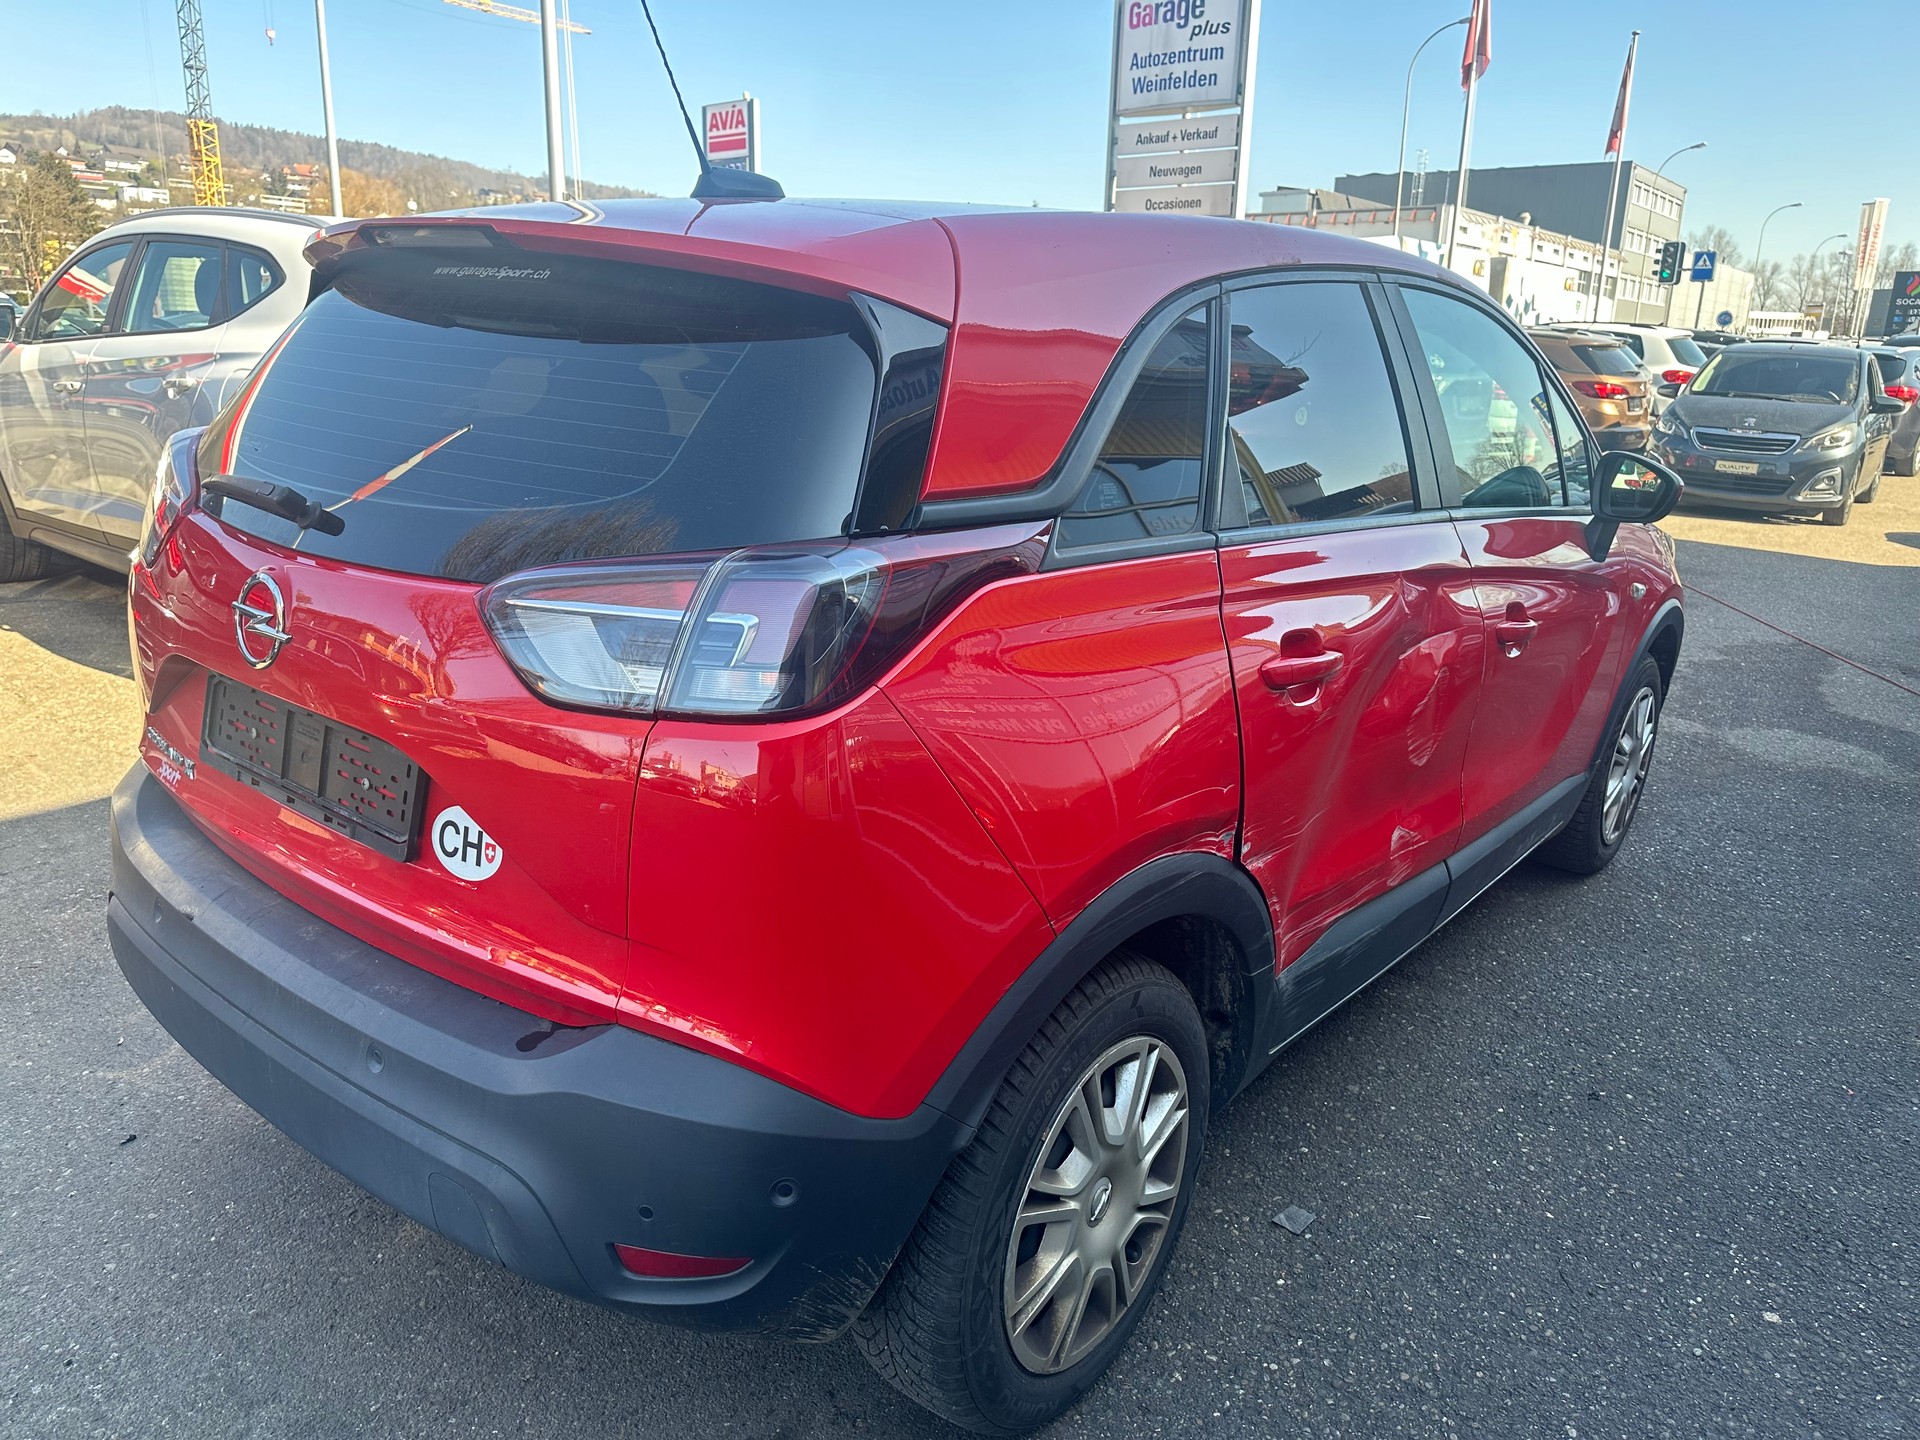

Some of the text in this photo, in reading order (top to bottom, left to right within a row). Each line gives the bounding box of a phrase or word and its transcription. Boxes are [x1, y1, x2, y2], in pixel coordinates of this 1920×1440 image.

[1129, 0, 1205, 29] Garage
[1189, 20, 1231, 41] plus
[1130, 46, 1224, 71] Autozentrum
[1132, 70, 1218, 95] Weinfelden
[1135, 126, 1219, 146] Ankauf + Verkauf
[1149, 165, 1202, 179] Neuwagen
[1145, 197, 1202, 211] Occasionen
[438, 819, 484, 868] CH
